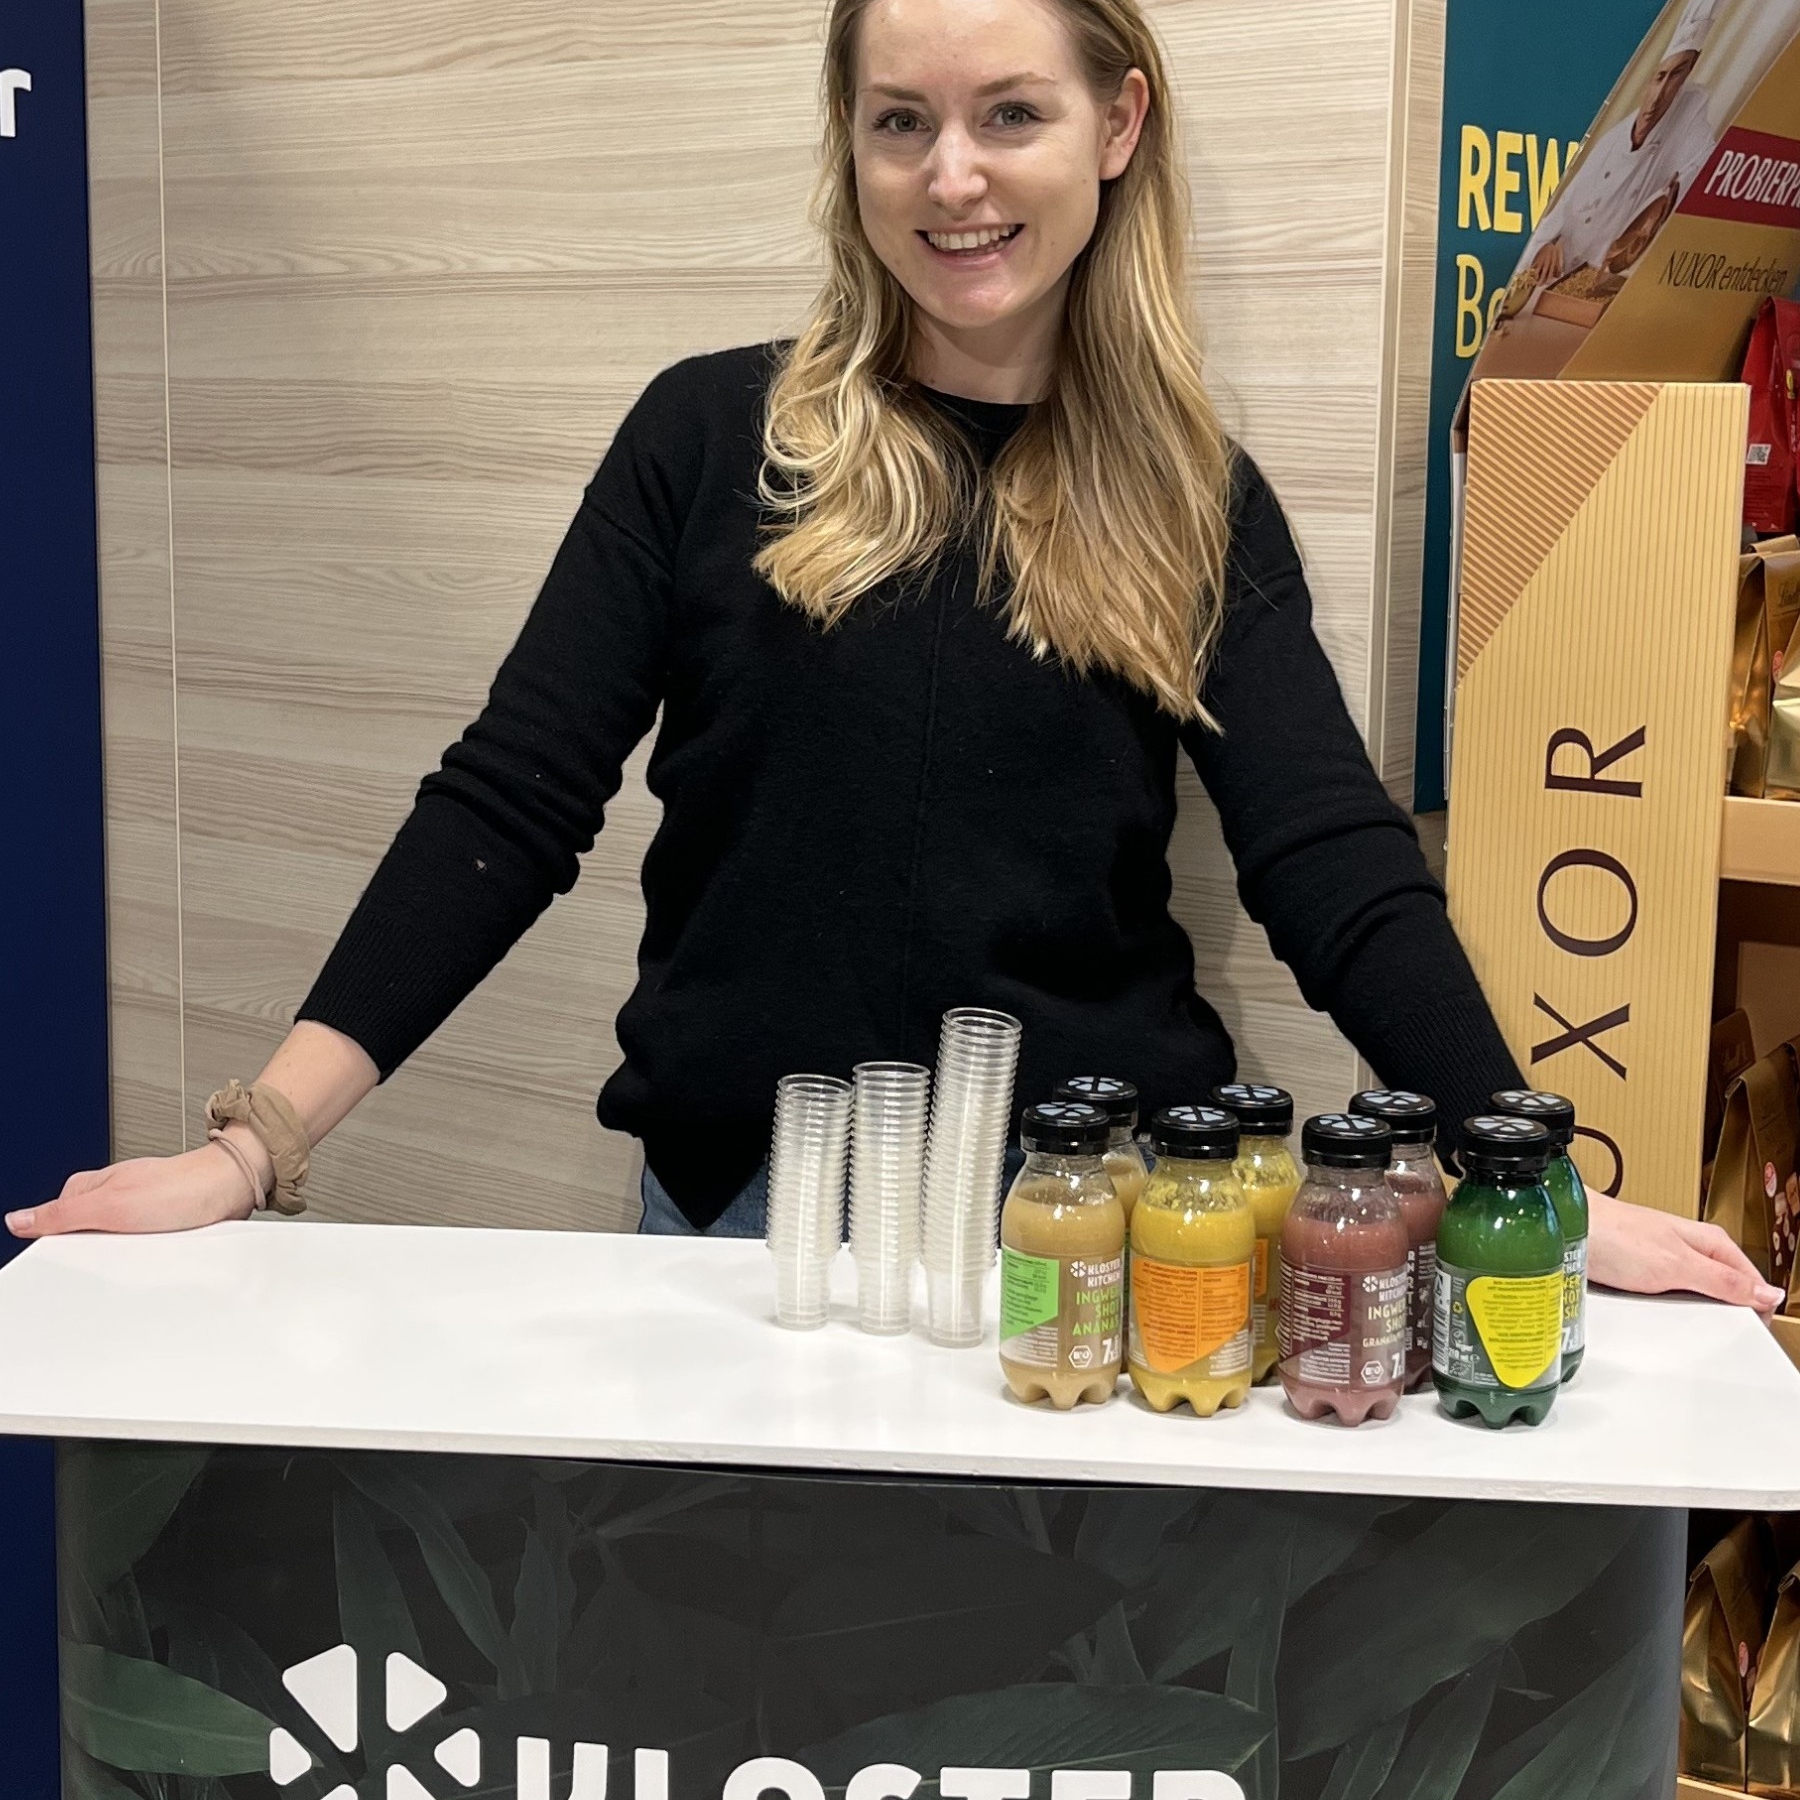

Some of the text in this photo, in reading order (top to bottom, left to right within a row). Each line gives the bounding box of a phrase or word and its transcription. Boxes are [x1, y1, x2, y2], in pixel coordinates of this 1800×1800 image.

[1457, 124, 1584, 235] REW
[1530, 725, 1646, 1198] XOR
[1076, 1286, 1120, 1305] INGWE
[1367, 1298, 1406, 1320] INGWE
